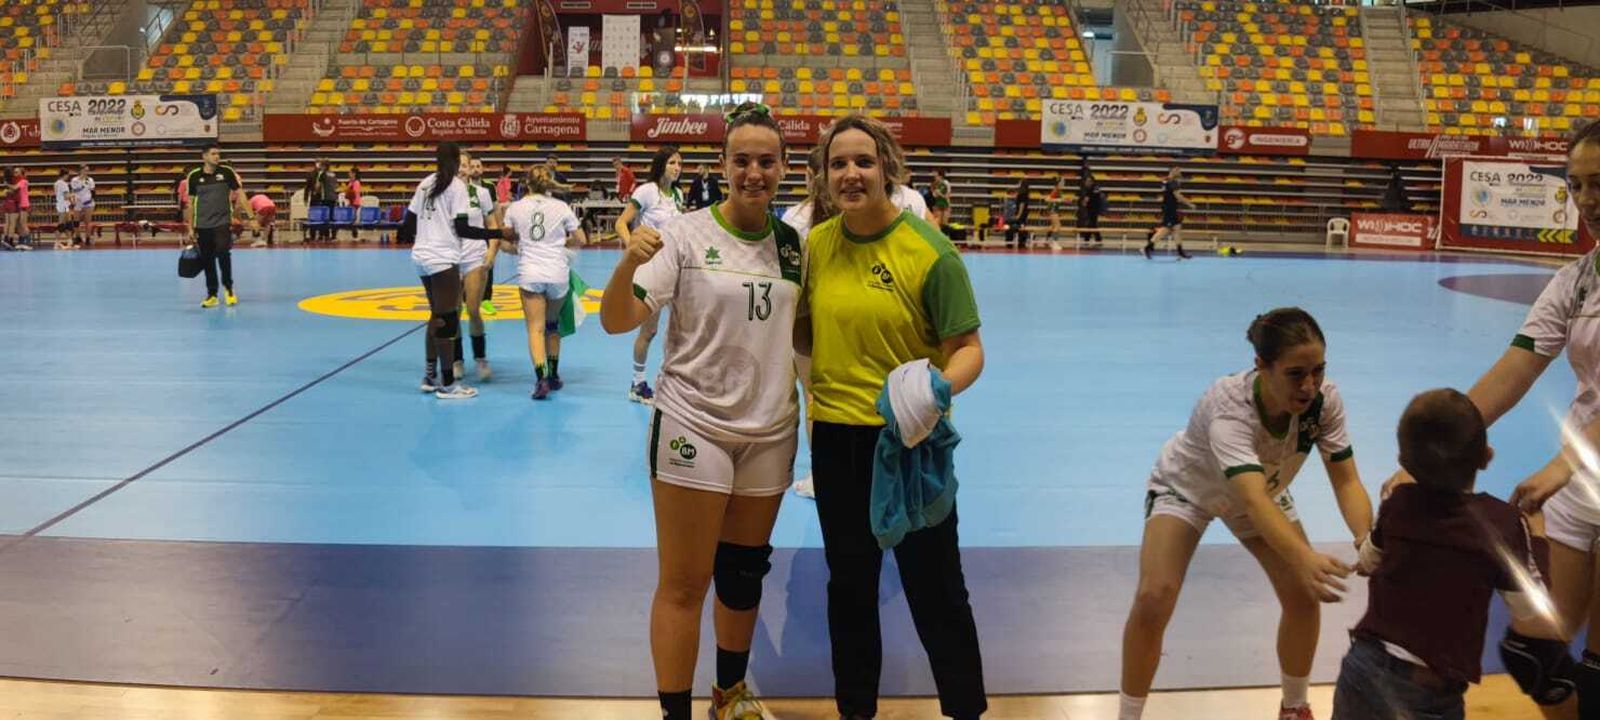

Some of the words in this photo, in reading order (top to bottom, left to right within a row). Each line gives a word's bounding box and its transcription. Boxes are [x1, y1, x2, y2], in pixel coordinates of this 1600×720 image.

[48, 101, 81, 112] CESA
[88, 99, 126, 112] 2022
[1050, 103, 1083, 114] CESA
[1091, 104, 1129, 117] 2022
[427, 117, 455, 128] Costa
[458, 117, 490, 127] Cálida
[647, 117, 708, 138] Jimbee
[100, 126, 126, 134] MENOR
[525, 124, 580, 136] Cartagena
[1470, 171, 1501, 182] CESA
[530, 211, 545, 241] 8
[742, 281, 773, 321] 13
